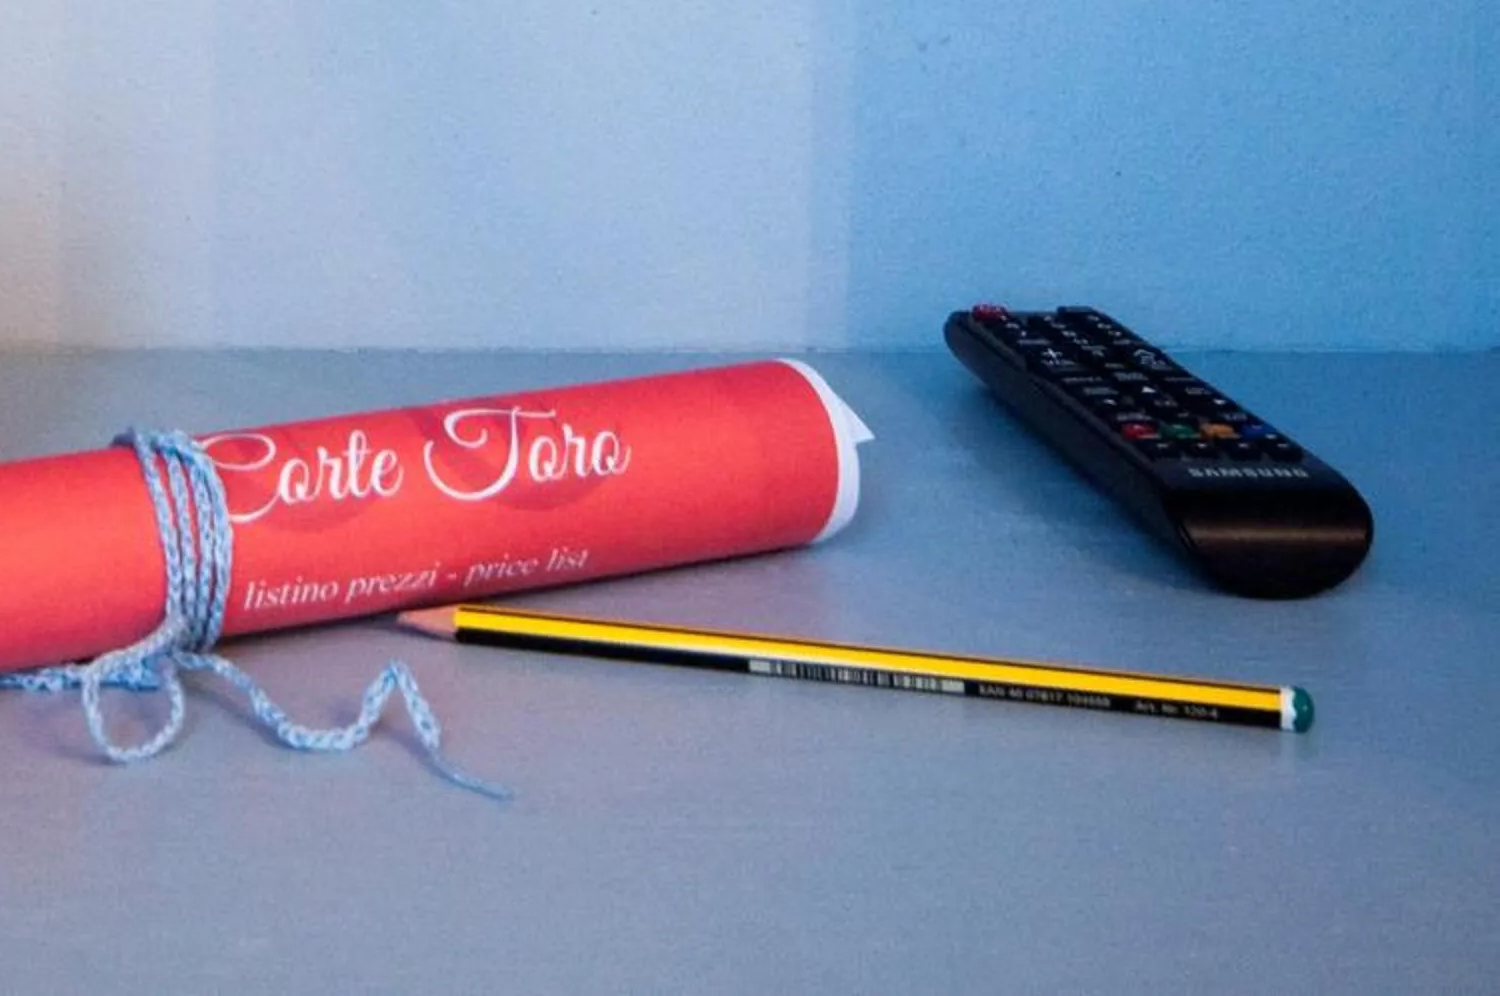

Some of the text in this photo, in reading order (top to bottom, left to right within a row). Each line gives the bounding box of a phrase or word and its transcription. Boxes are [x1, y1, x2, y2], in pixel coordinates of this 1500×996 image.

[202, 405, 632, 524] Corte Toro
[1187, 466, 1310, 479] SAMSUNG
[243, 574, 339, 612] listino
[344, 561, 440, 605] prezzi
[463, 553, 541, 591] price
[546, 545, 591, 574] list
